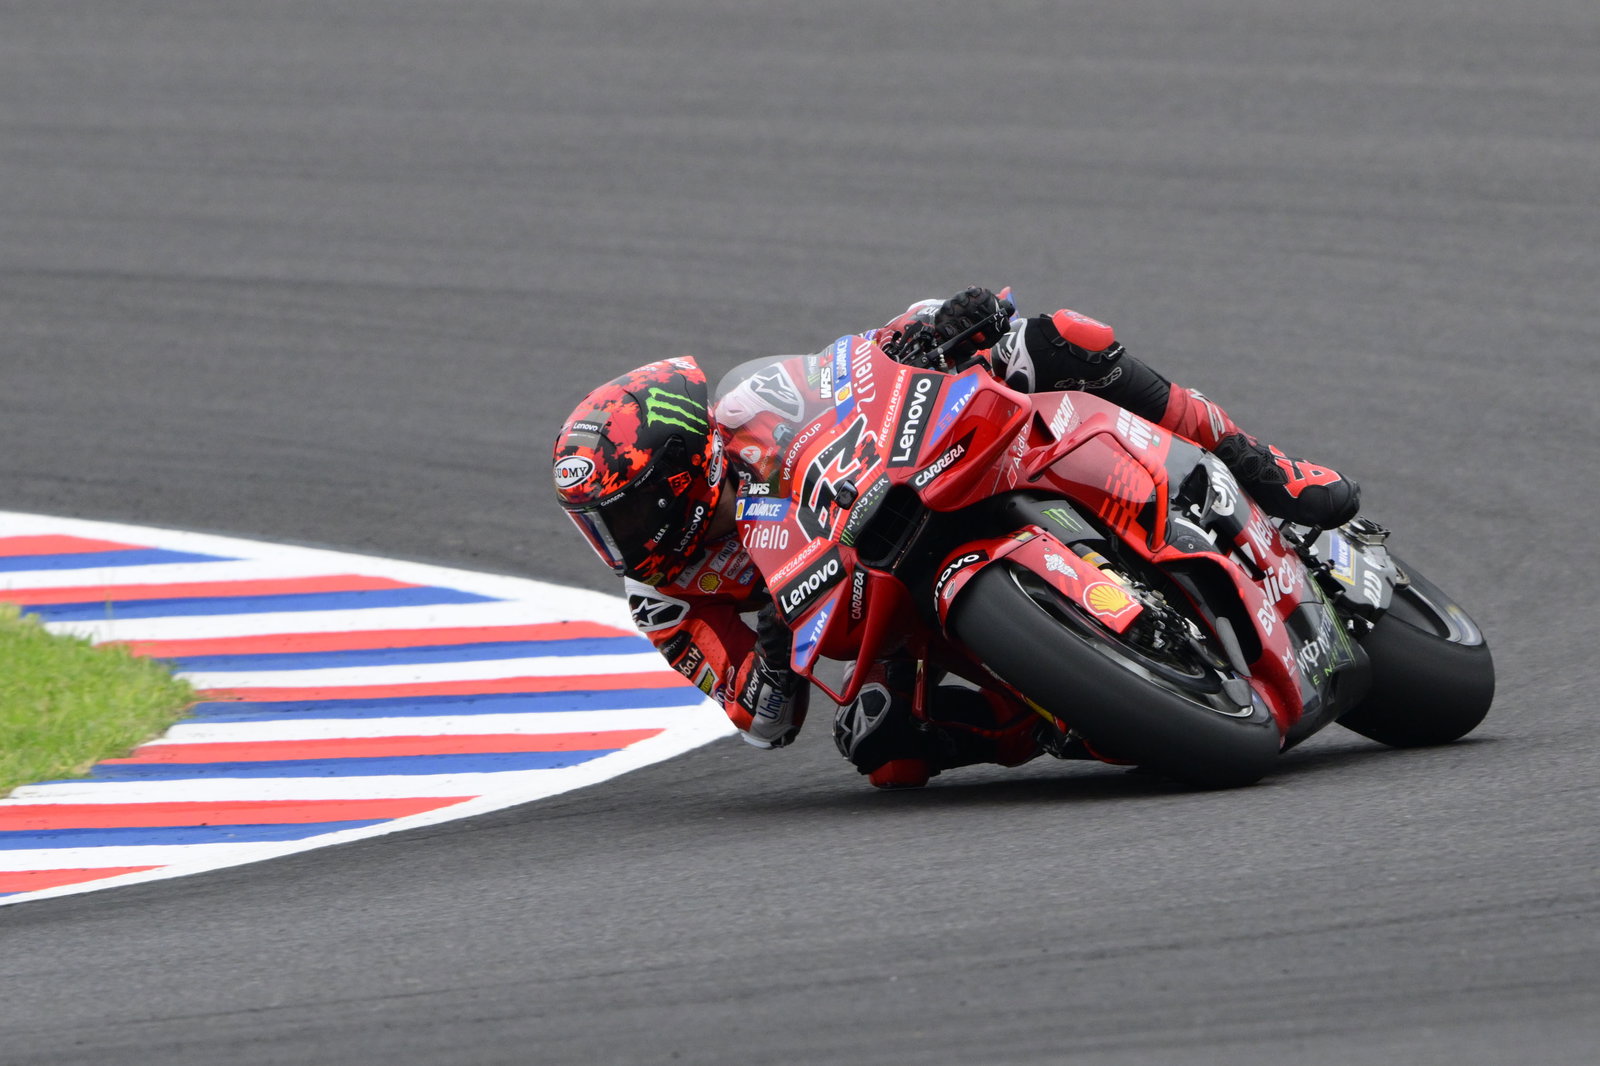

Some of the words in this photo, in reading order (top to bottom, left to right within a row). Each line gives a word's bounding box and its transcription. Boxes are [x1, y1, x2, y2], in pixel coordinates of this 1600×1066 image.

[878, 369, 907, 448] FRECCIAROSSA
[892, 378, 932, 461] Lenovo
[951, 386, 976, 413] TIM
[1049, 393, 1075, 442] DUCATI
[573, 422, 598, 431] Lenovo
[783, 423, 822, 480] VARGROUP
[915, 444, 965, 486] CARRERA
[1012, 432, 1026, 469] Audi
[749, 483, 770, 494] WRS
[673, 506, 704, 552] Lenovo
[769, 538, 822, 586] FRECCIAROSSA
[780, 558, 839, 614] Lenovo
[851, 571, 865, 620] CARRERA
[809, 611, 828, 649] TIM
